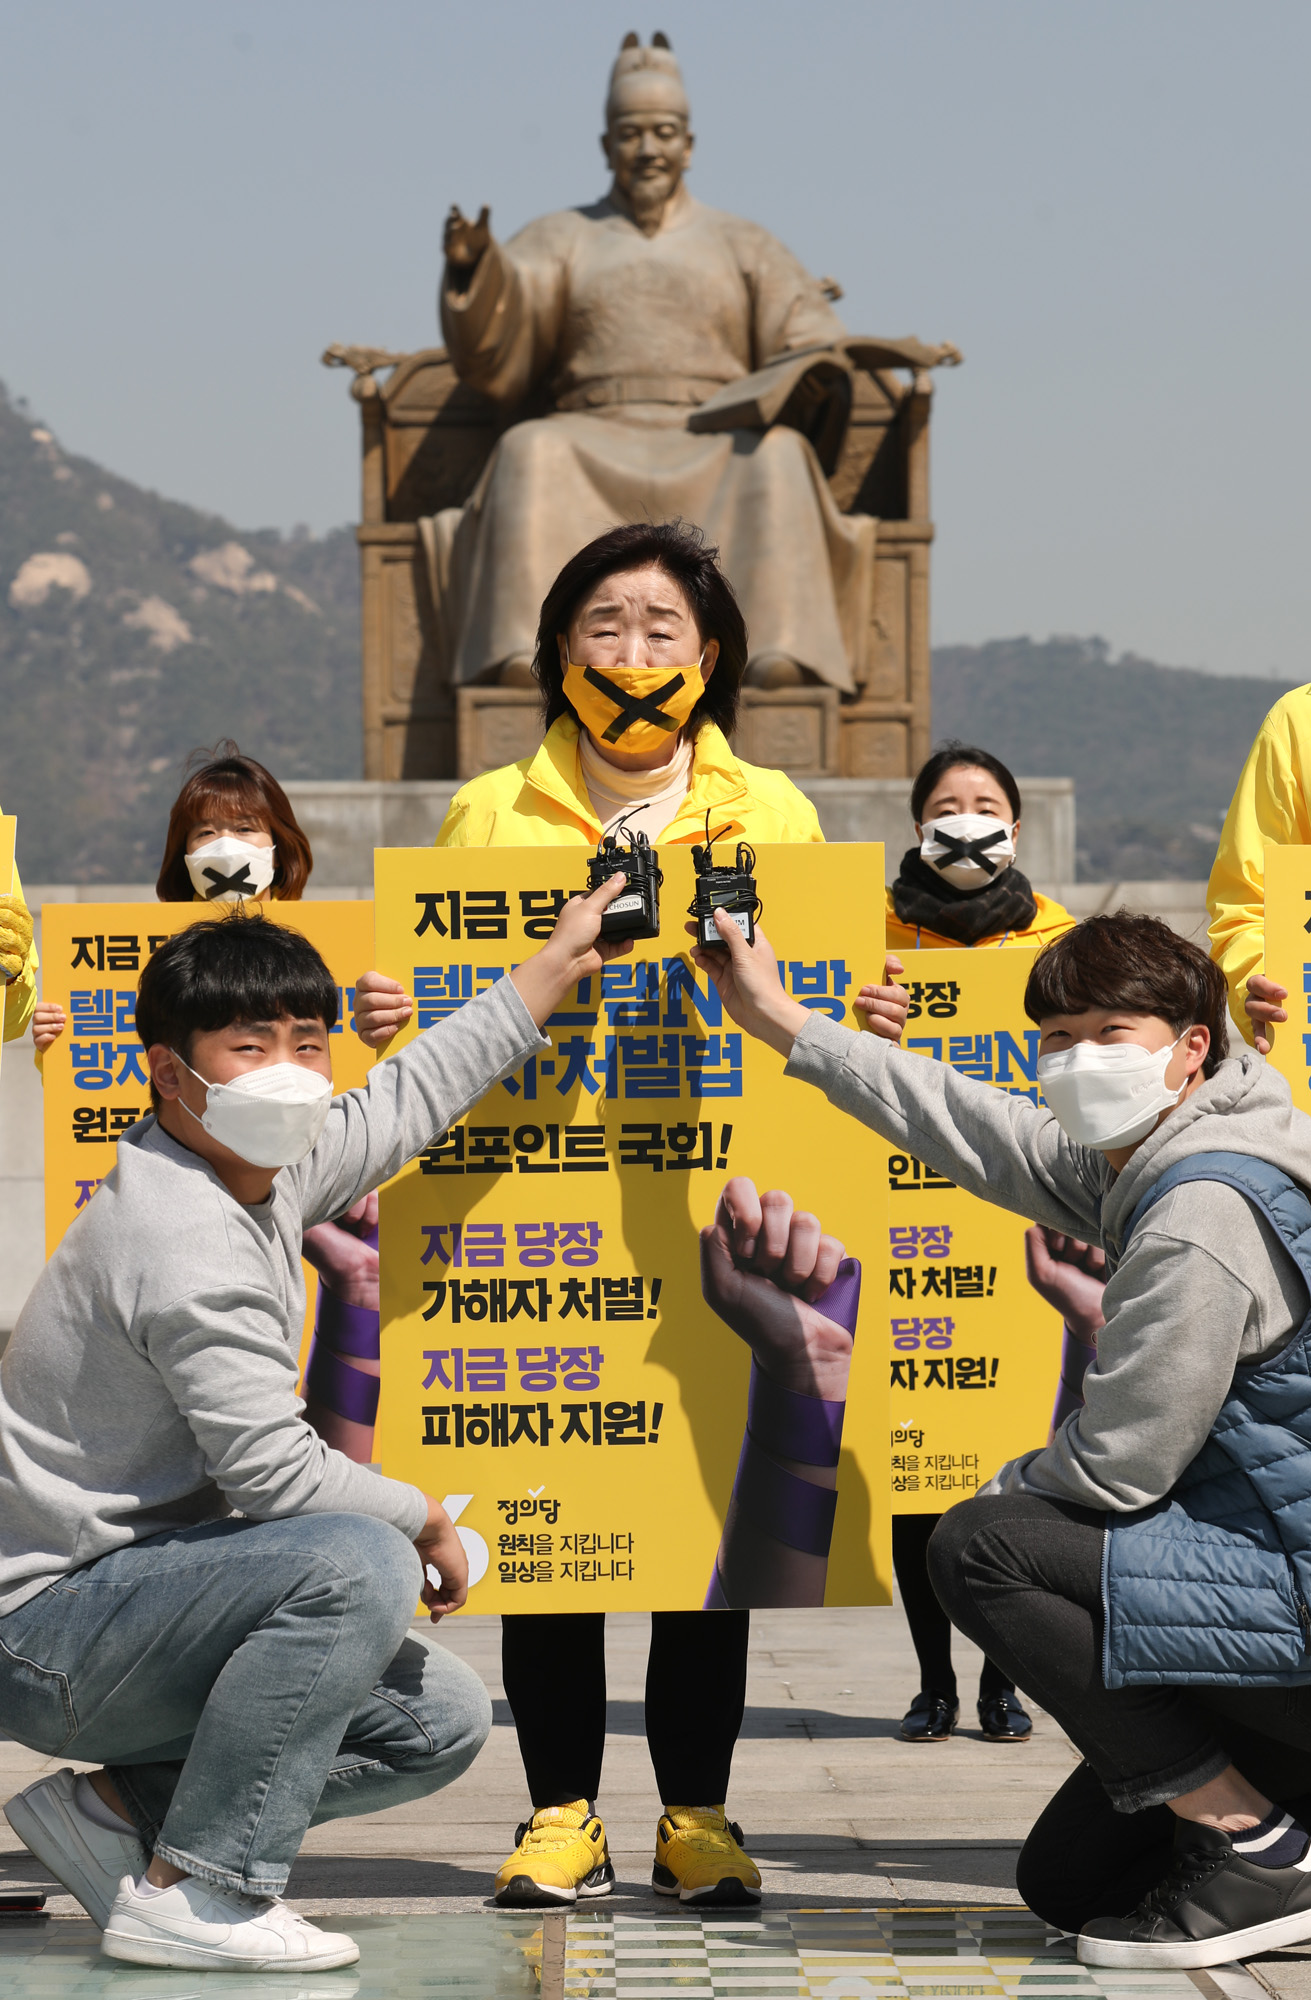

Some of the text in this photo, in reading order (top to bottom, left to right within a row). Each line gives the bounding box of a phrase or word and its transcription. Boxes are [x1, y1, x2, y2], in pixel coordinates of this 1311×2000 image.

[413, 889, 592, 940] 지금 당
[608, 900, 640, 911] CHOSUN
[70, 935, 141, 971] 지금
[417, 1121, 733, 1175] 원포인트 국회!
[420, 1221, 603, 1268] 지금 당장
[889, 1225, 954, 1260] 당장
[421, 1275, 663, 1324] 가해자 처벌!
[921, 1265, 998, 1299] 처벌!
[890, 1316, 956, 1351] 당장
[421, 1345, 605, 1393] 지금 당장
[923, 1356, 1000, 1391] 지원!
[421, 1400, 664, 1448] 피해자 지원!
[890, 1429, 926, 1449] 의당
[924, 1453, 980, 1471] 지킵니다
[924, 1473, 980, 1491] 지킵니다
[497, 1499, 561, 1525] 정의당
[497, 1532, 635, 1556] 원칙을 지킵니다
[497, 1559, 635, 1583] 일상을 지킵니다
